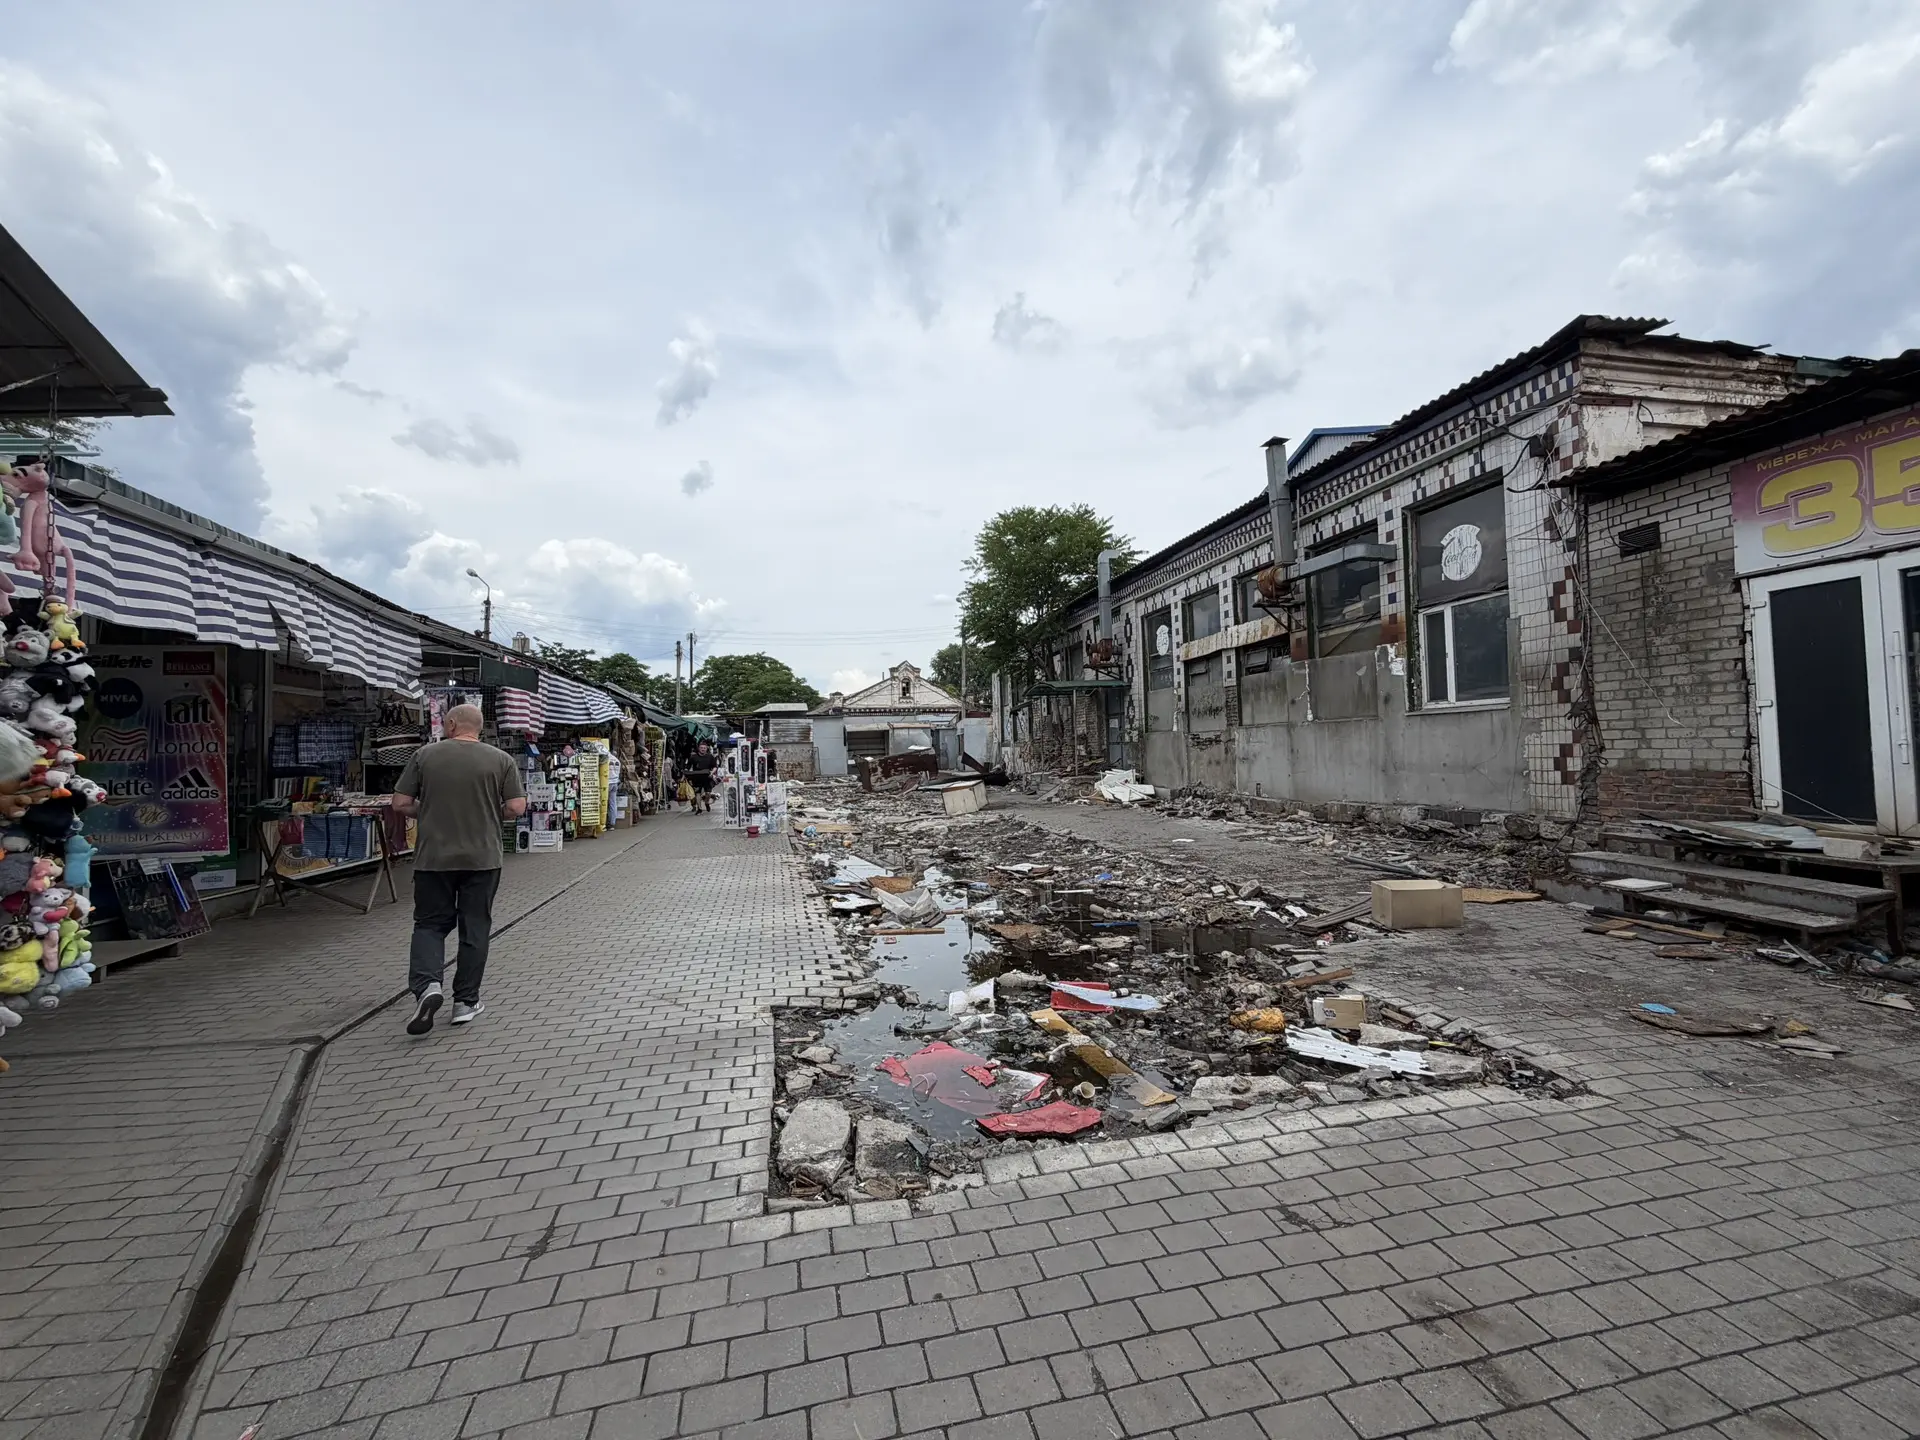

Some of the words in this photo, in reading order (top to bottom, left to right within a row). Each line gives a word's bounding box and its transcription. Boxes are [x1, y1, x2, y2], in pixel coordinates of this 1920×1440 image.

[1756, 439, 1846, 472] МЕРЕЖА
[99, 693, 138, 703] NIVEA
[164, 694, 211, 724] taft
[154, 735, 219, 754] Londa
[88, 748, 147, 762] WELLA
[160, 787, 219, 800] adidas
